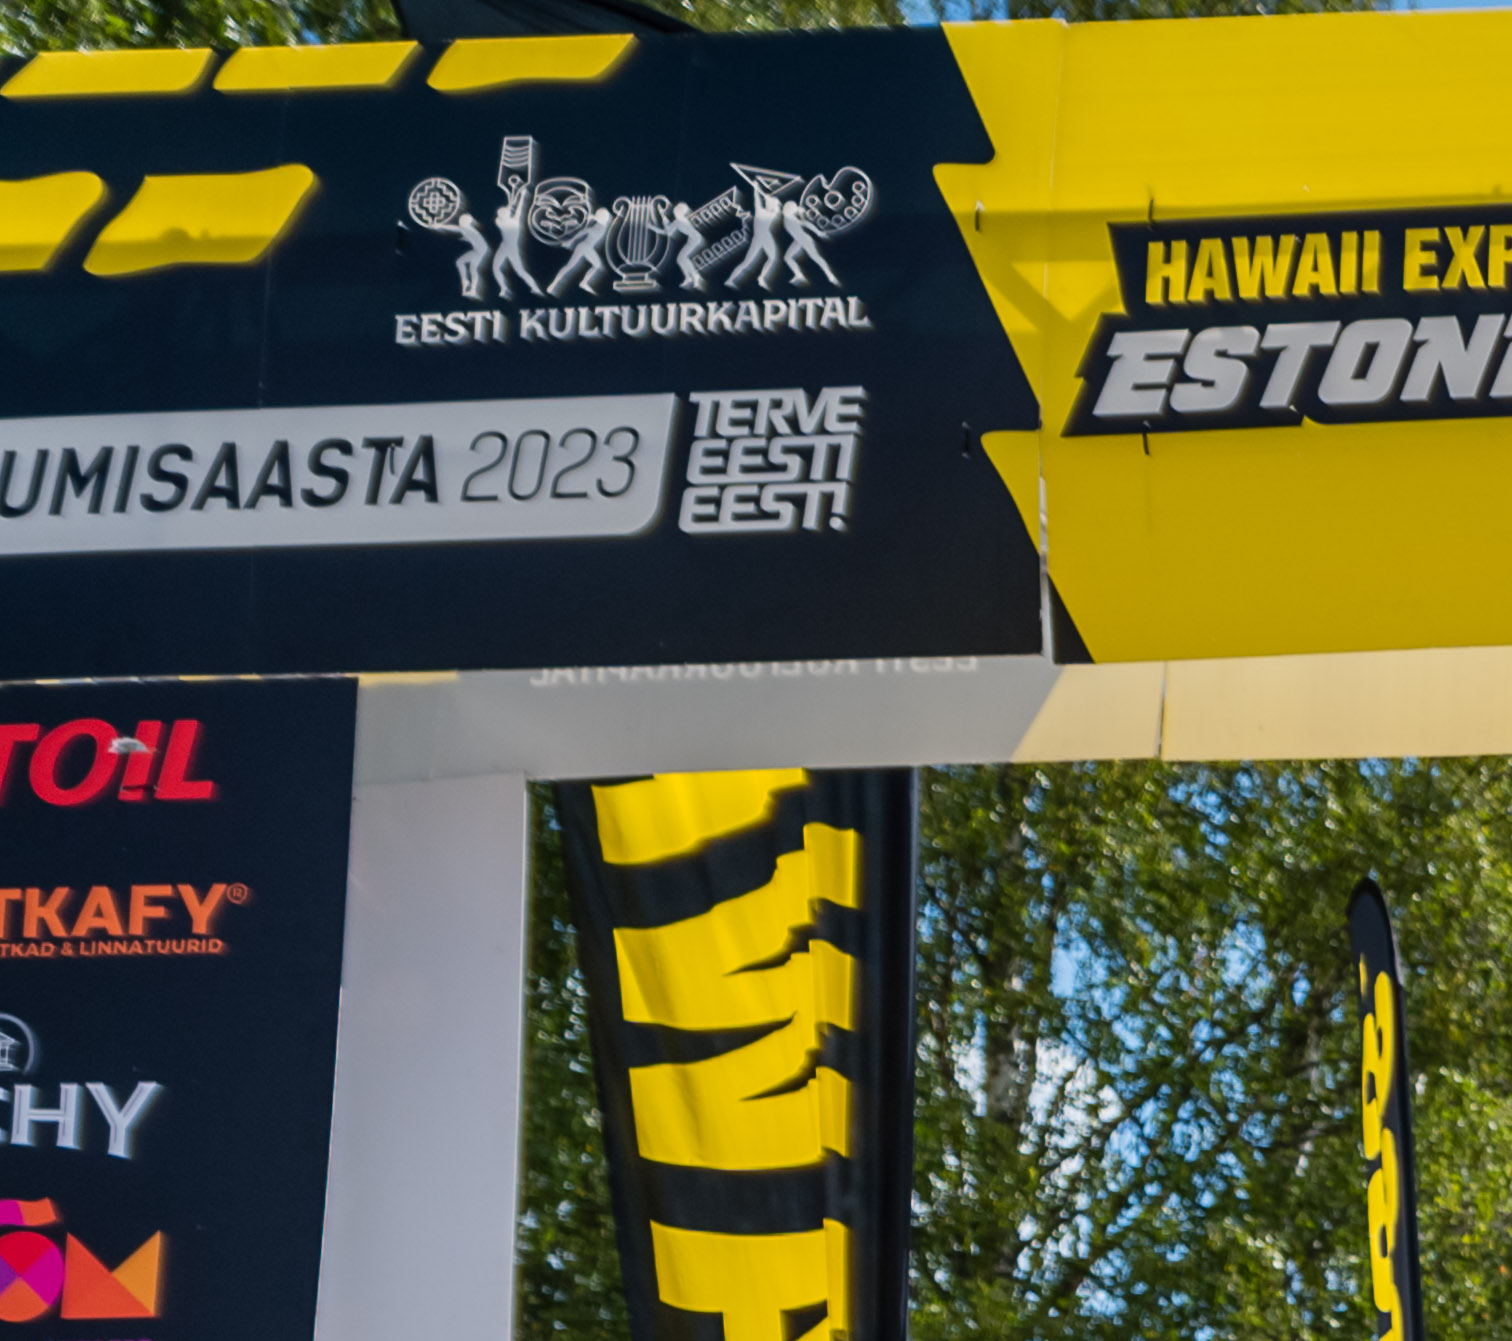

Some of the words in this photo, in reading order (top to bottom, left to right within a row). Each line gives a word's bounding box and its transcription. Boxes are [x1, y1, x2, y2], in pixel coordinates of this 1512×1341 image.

[1145, 234, 1380, 305] HAWAII
[396, 312, 507, 345] EESTI
[520, 296, 872, 341] KULTUURKAPITAL
[689, 386, 864, 438] TERVE
[462, 427, 641, 503] 2023
[60, 941, 73, 957] &
[79, 938, 224, 957] LINNATUURID
[0, 1081, 164, 1160] HY
